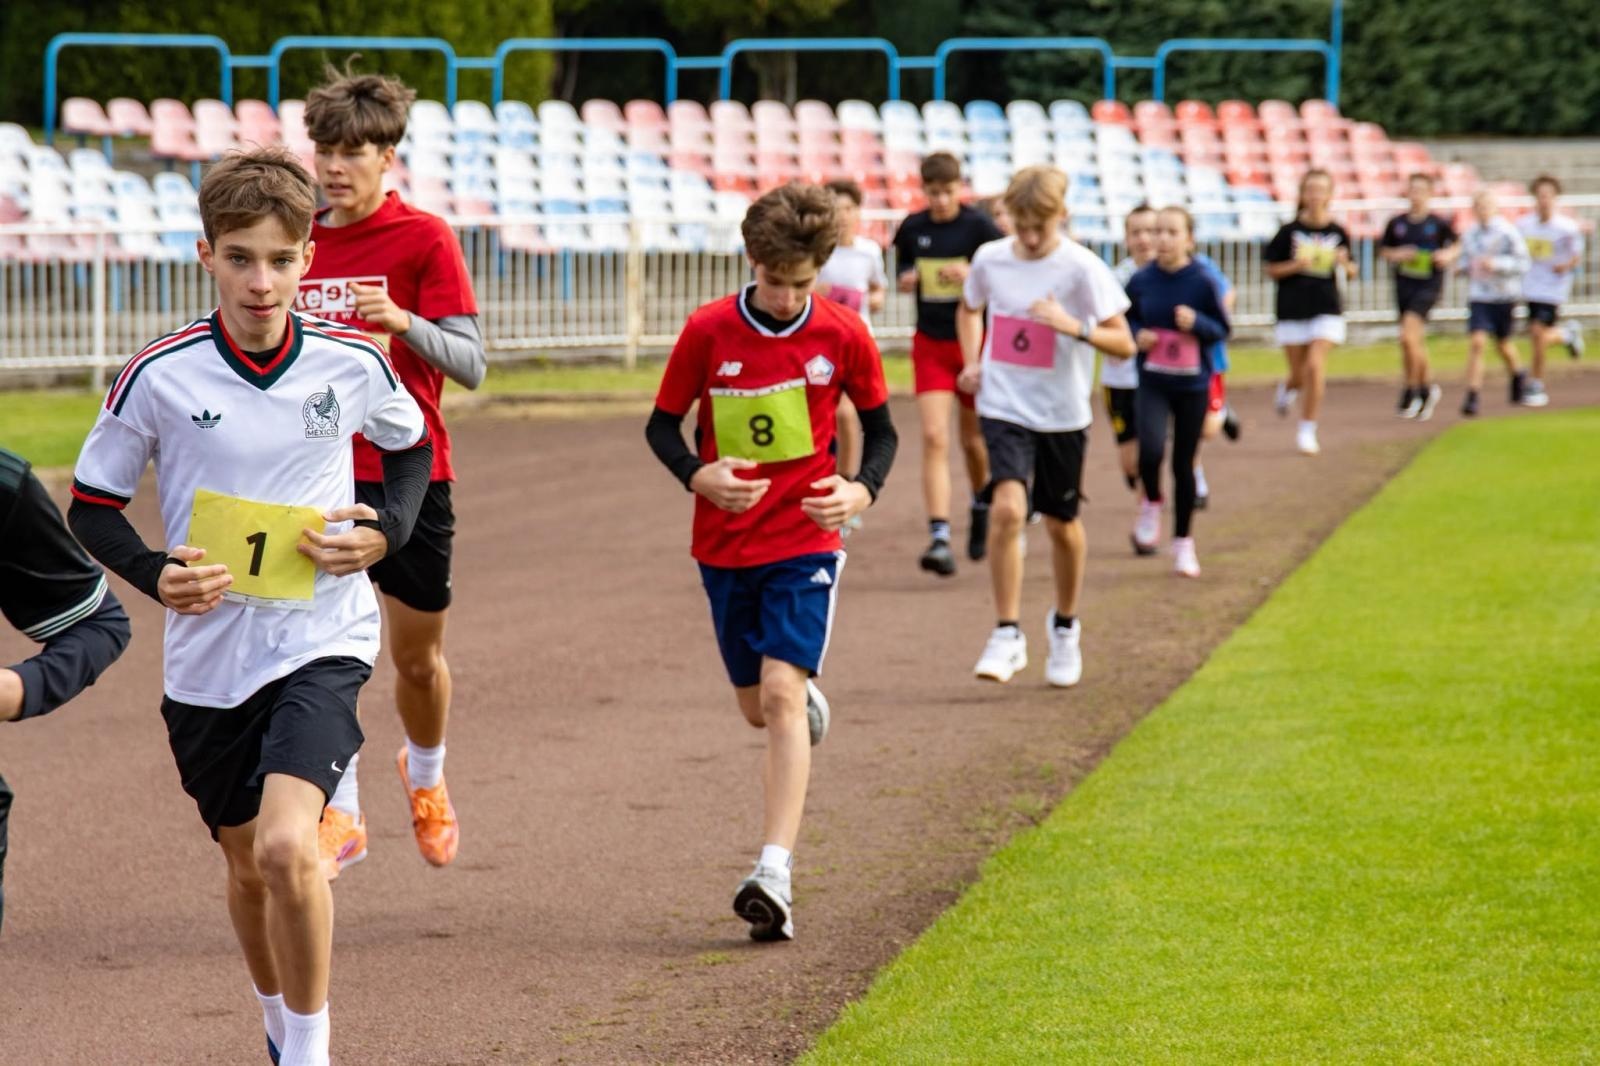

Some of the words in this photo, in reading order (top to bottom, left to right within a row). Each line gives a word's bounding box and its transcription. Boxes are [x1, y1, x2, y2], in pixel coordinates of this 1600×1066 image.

[1012, 327, 1029, 353] 6
[749, 414, 774, 447] 8
[246, 532, 267, 576] 1
